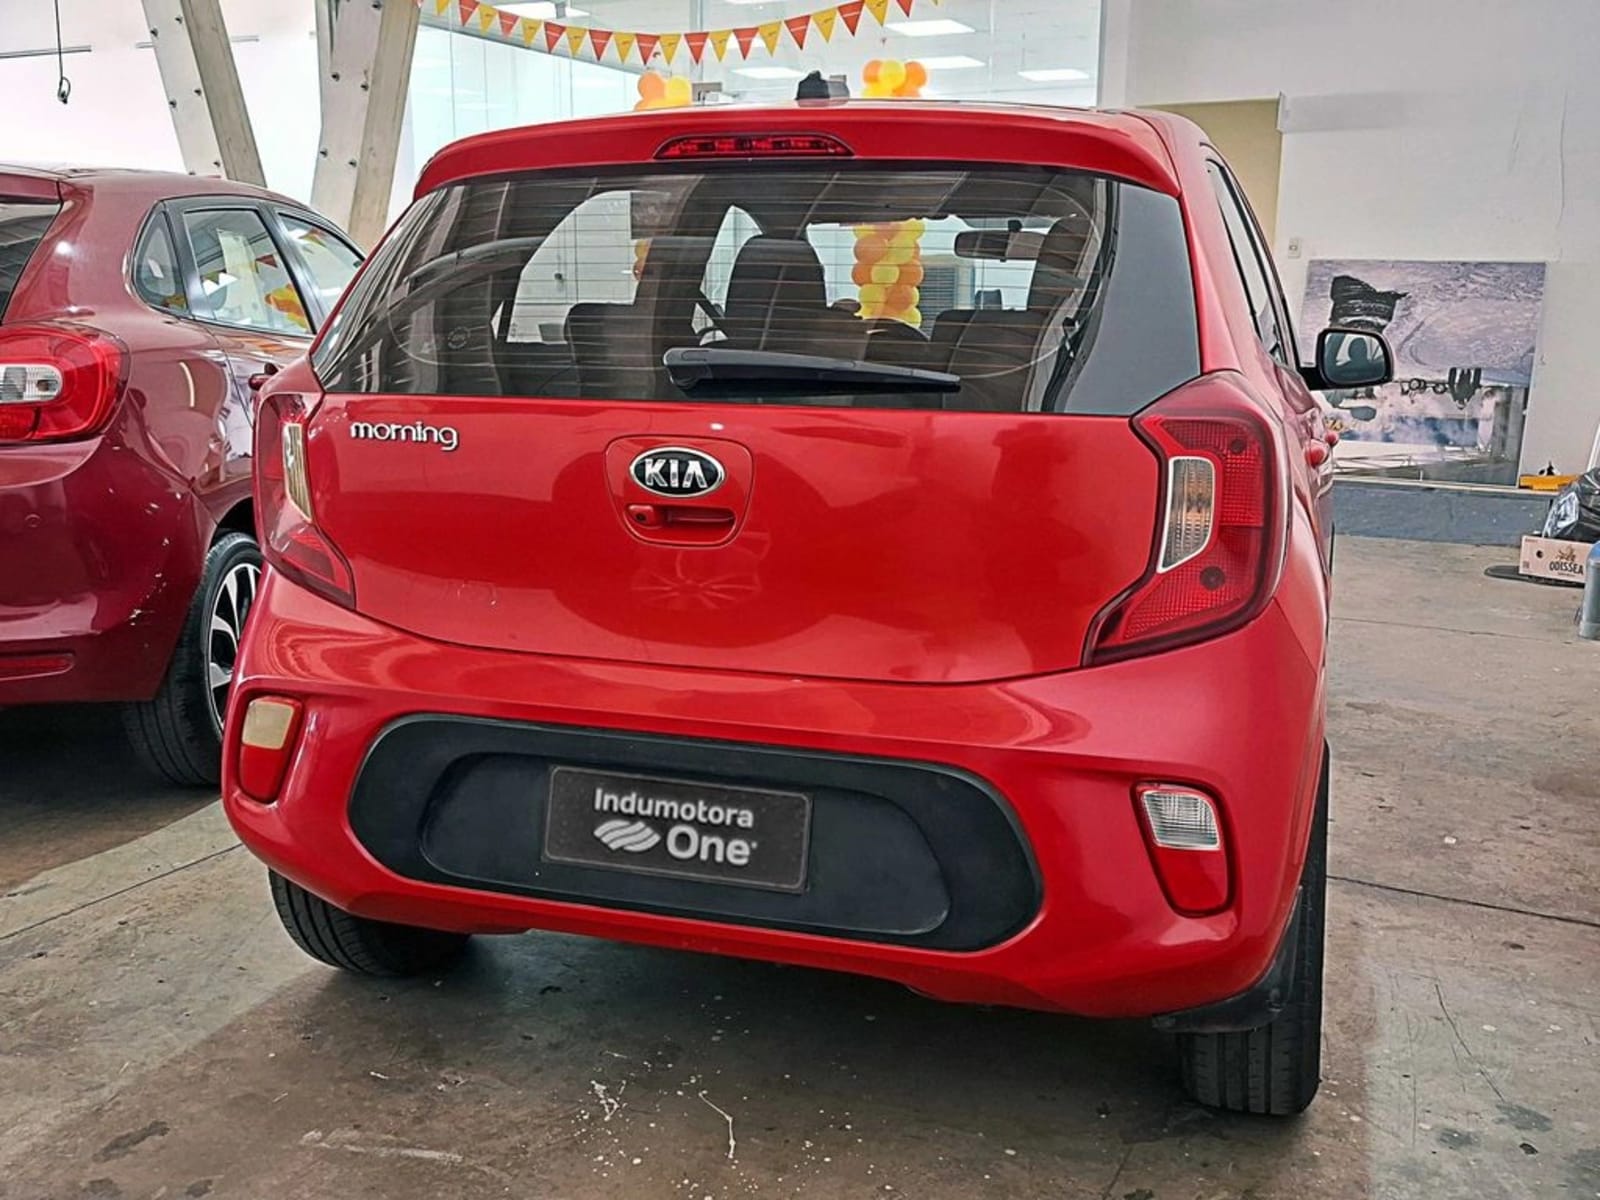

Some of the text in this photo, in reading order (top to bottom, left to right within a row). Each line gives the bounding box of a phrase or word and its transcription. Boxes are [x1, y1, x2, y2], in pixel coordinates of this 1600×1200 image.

[349, 420, 459, 451] morning
[643, 458, 709, 490] KIA
[1549, 561, 1584, 575] ODISSEA
[594, 788, 754, 828] Indumotora
[666, 824, 752, 866] One
